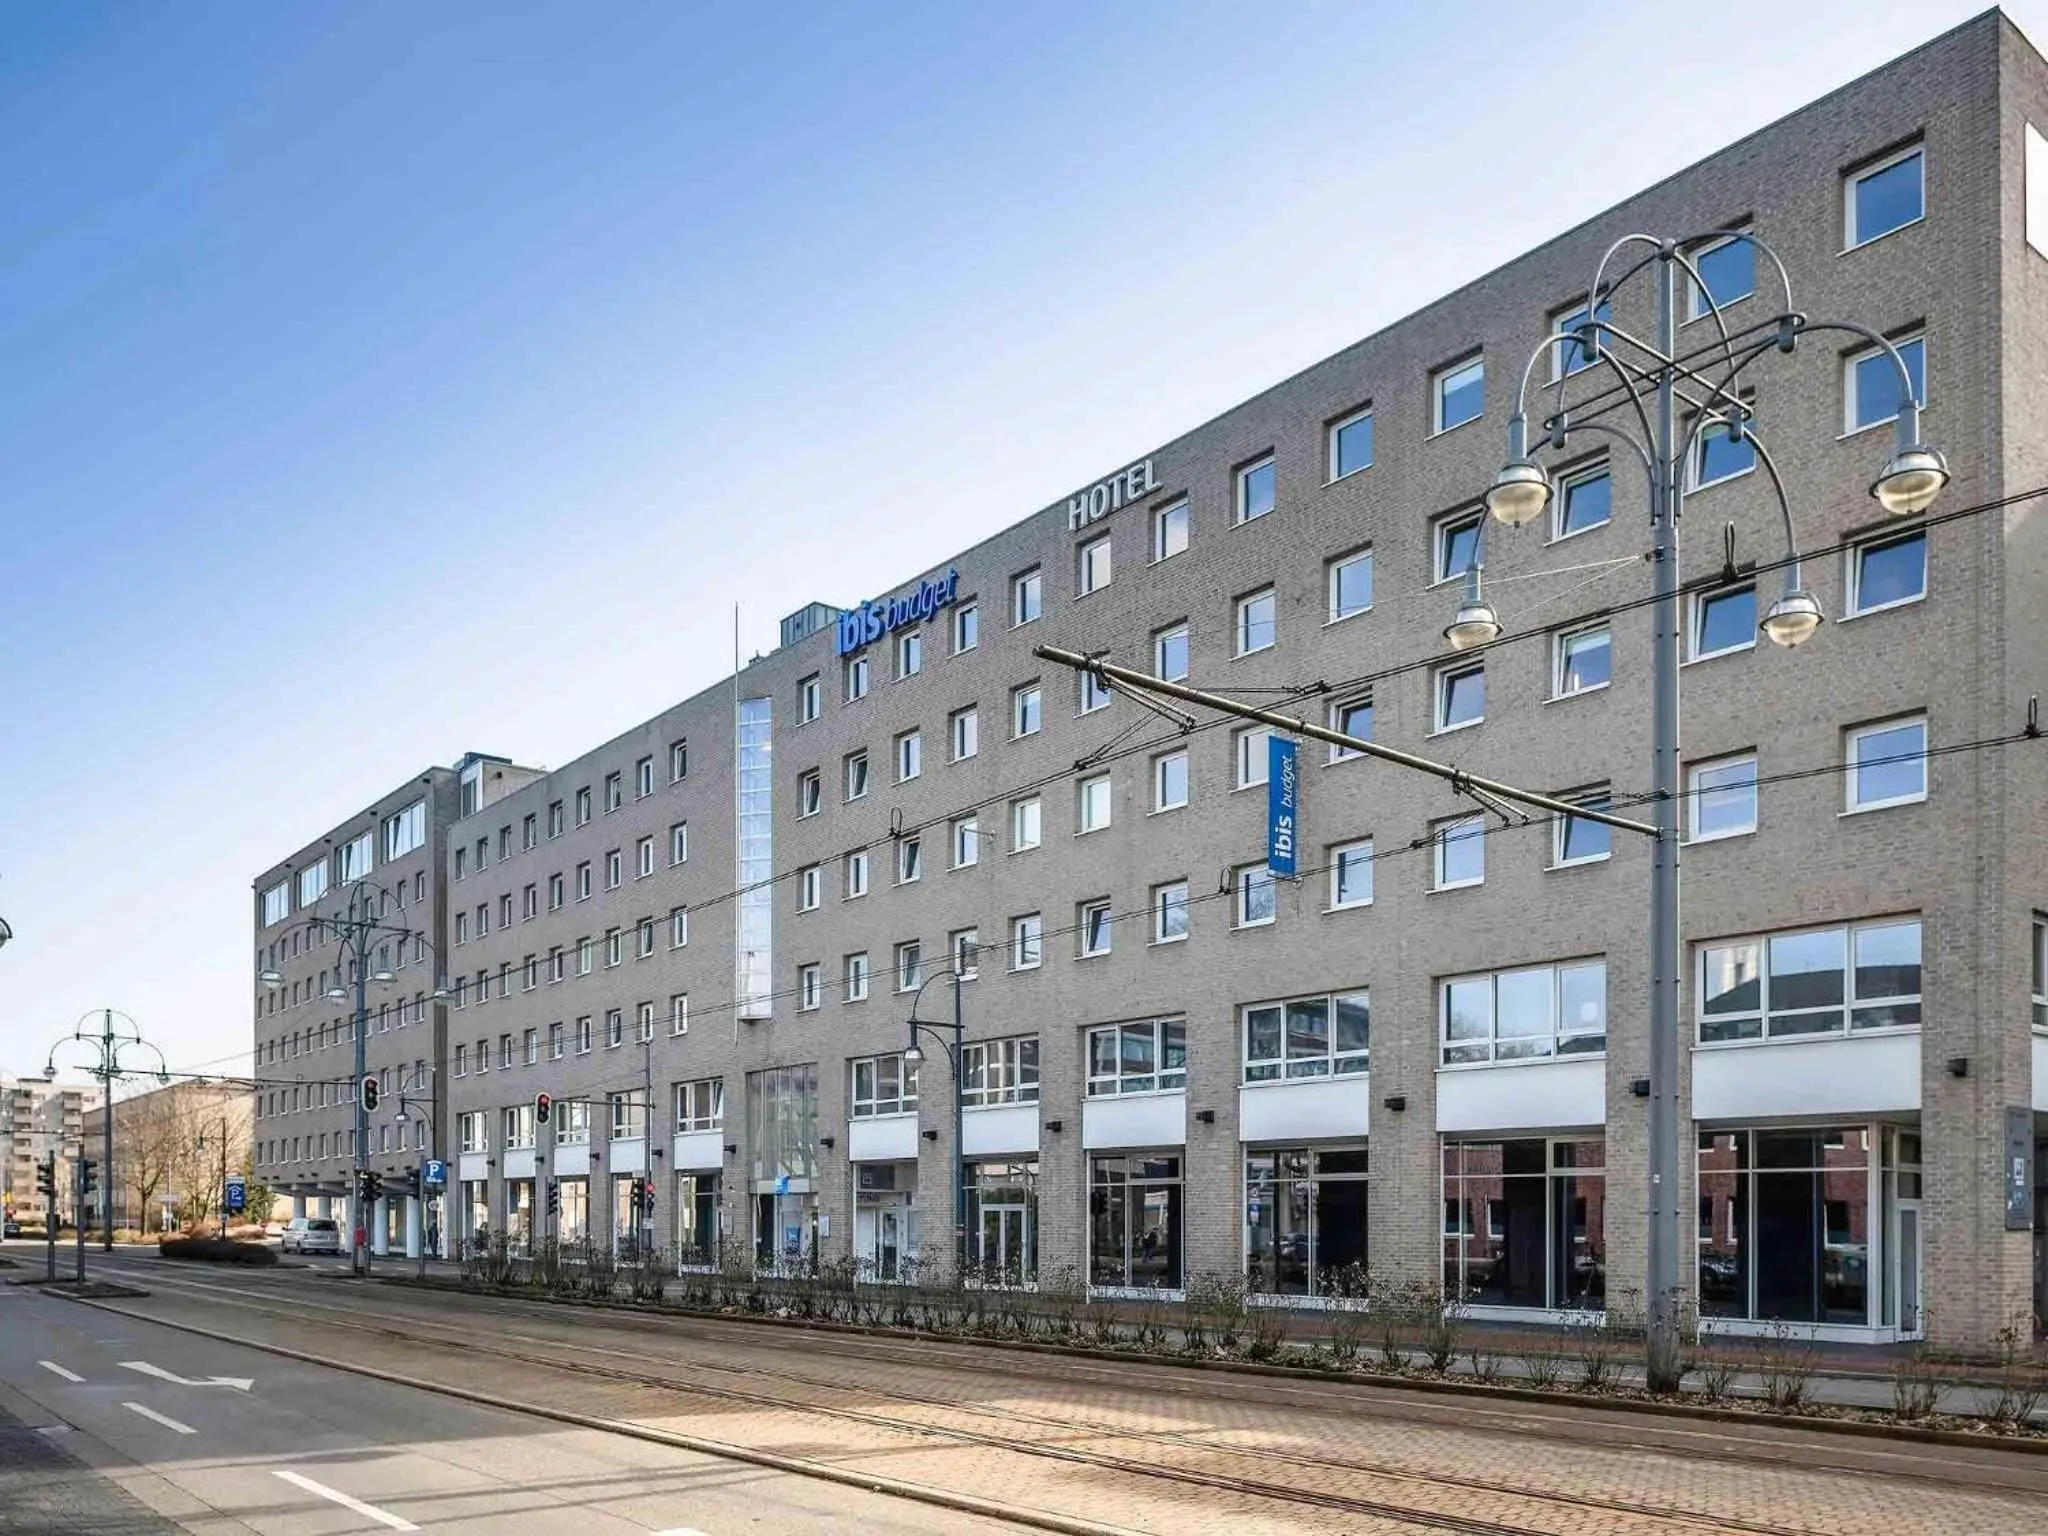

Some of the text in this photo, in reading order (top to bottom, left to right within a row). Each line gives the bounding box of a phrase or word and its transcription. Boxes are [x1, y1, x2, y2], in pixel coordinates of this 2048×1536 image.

[1067, 458, 1163, 532] HOTEL
[836, 567, 959, 656] ibis budget
[1274, 755, 1296, 859] ibis budget
[429, 1164, 440, 1177] P
